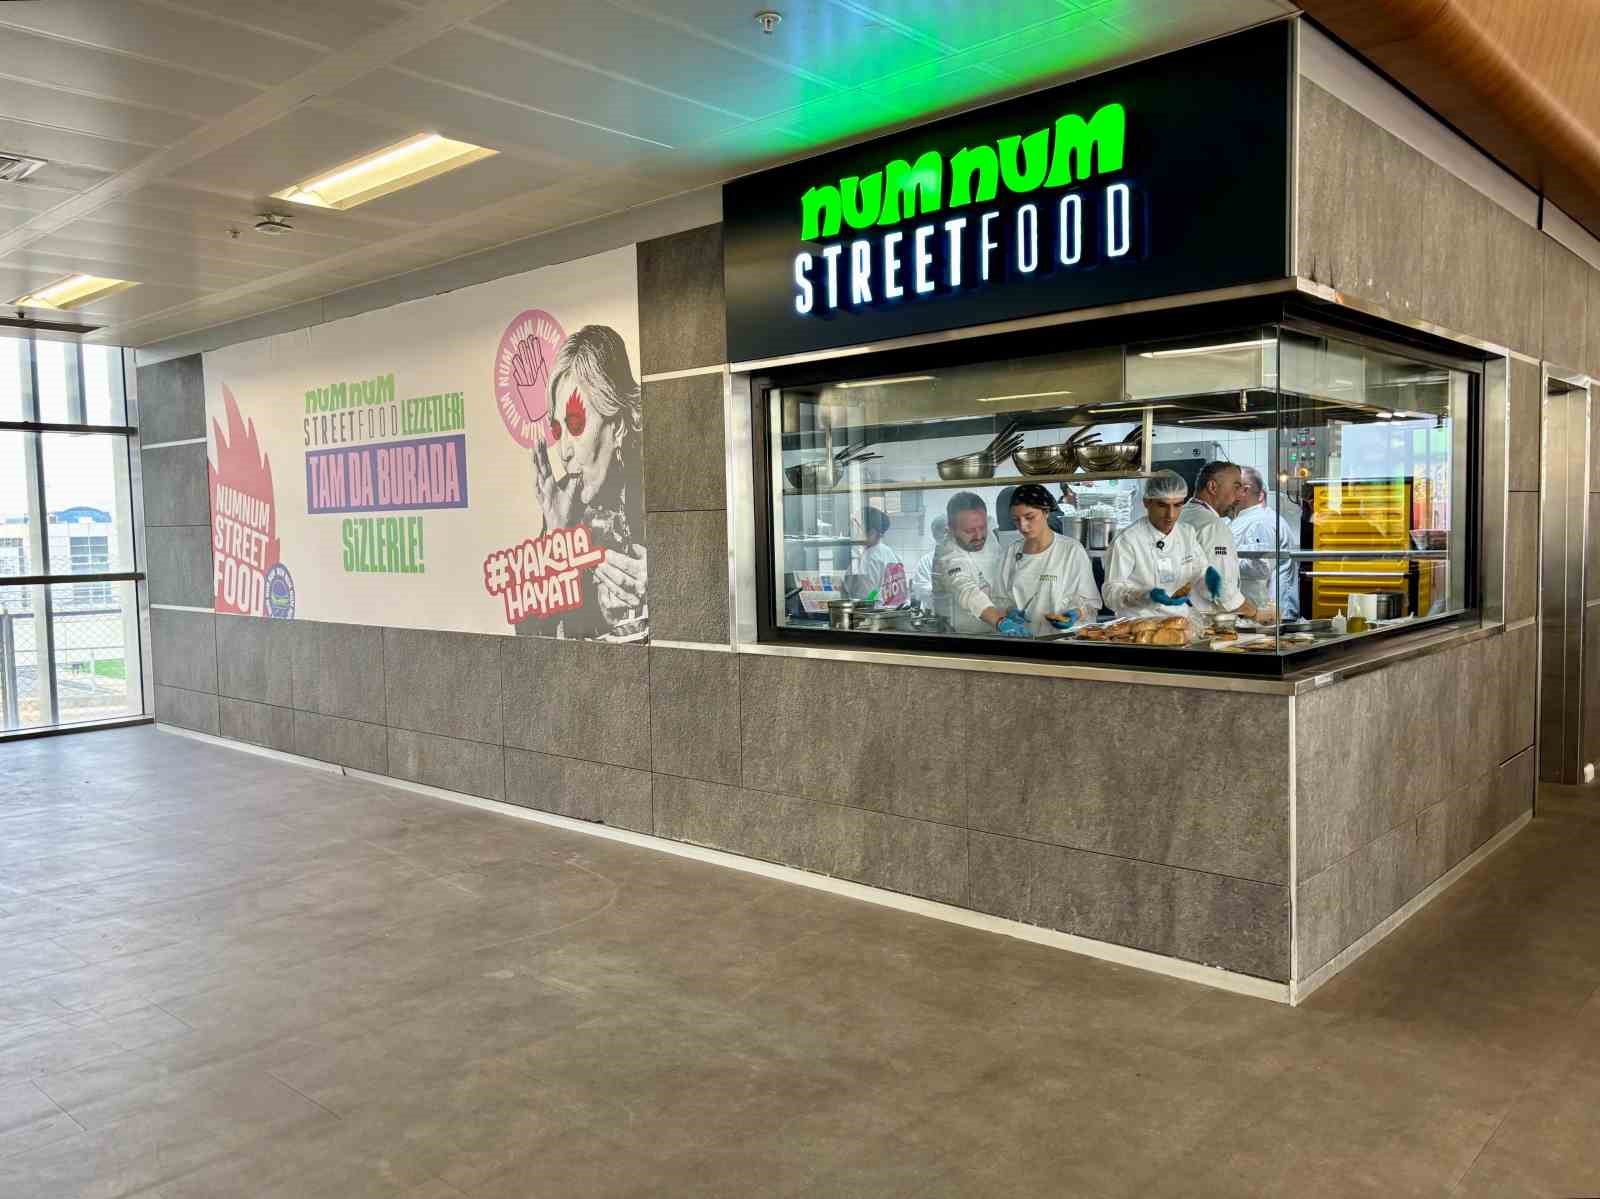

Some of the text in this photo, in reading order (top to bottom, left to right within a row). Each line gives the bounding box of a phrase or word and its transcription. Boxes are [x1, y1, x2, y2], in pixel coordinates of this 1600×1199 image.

[216, 483, 270, 533] NUMNUM
[309, 442, 461, 509] TAM DA BURADA
[215, 514, 269, 571] STREET
[487, 527, 603, 592] #YAKALA
[213, 551, 265, 617] FOOD
